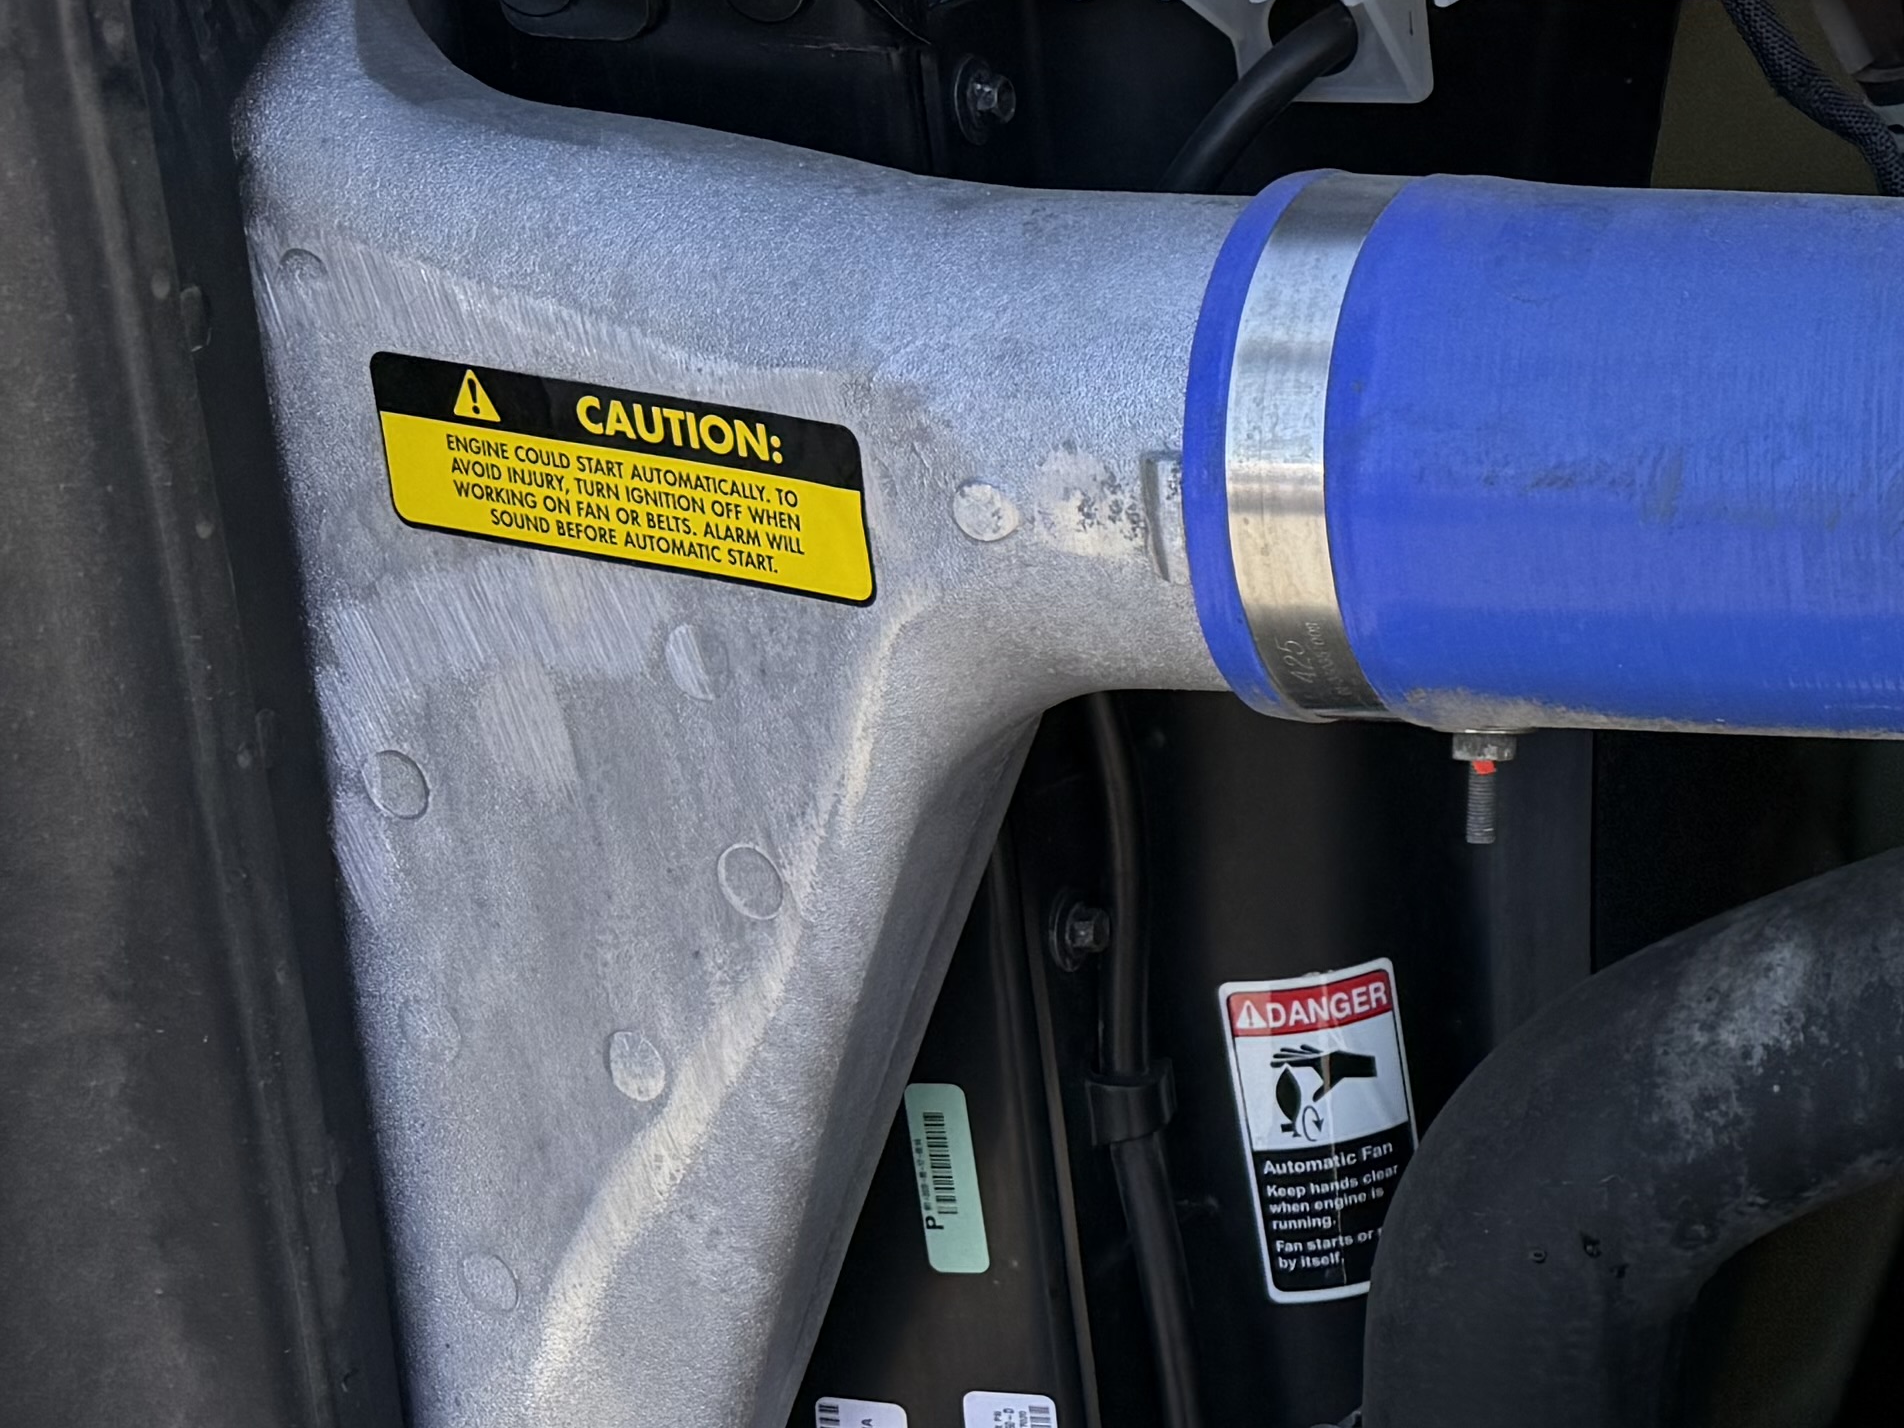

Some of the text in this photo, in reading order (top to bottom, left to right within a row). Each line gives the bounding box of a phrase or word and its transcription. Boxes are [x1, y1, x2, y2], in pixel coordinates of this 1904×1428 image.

[575, 395, 785, 464] CAUTION:
[446, 433, 799, 508] ENGINE COULD START AUTOMATICALLY. TO
[451, 458, 802, 532] AVOID INJURY, TURN IGNITION OFF WHEN
[453, 479, 806, 555] WORKING ON FAN OR BELTS. ALARM WILL
[490, 508, 779, 574] SOUND BEFORE AUTOMATIC START.
[1265, 981, 1388, 1028] DANGER
[1263, 1142, 1393, 1176] Automatic Fan
[1266, 1164, 1399, 1199] Keep hands clear
[1269, 1186, 1385, 1214] when engine is
[925, 1216, 944, 1229] P
[1272, 1214, 1337, 1232] running.
[1275, 1229, 1374, 1253] Fan starts or
[1278, 1251, 1345, 1272] by itself.
